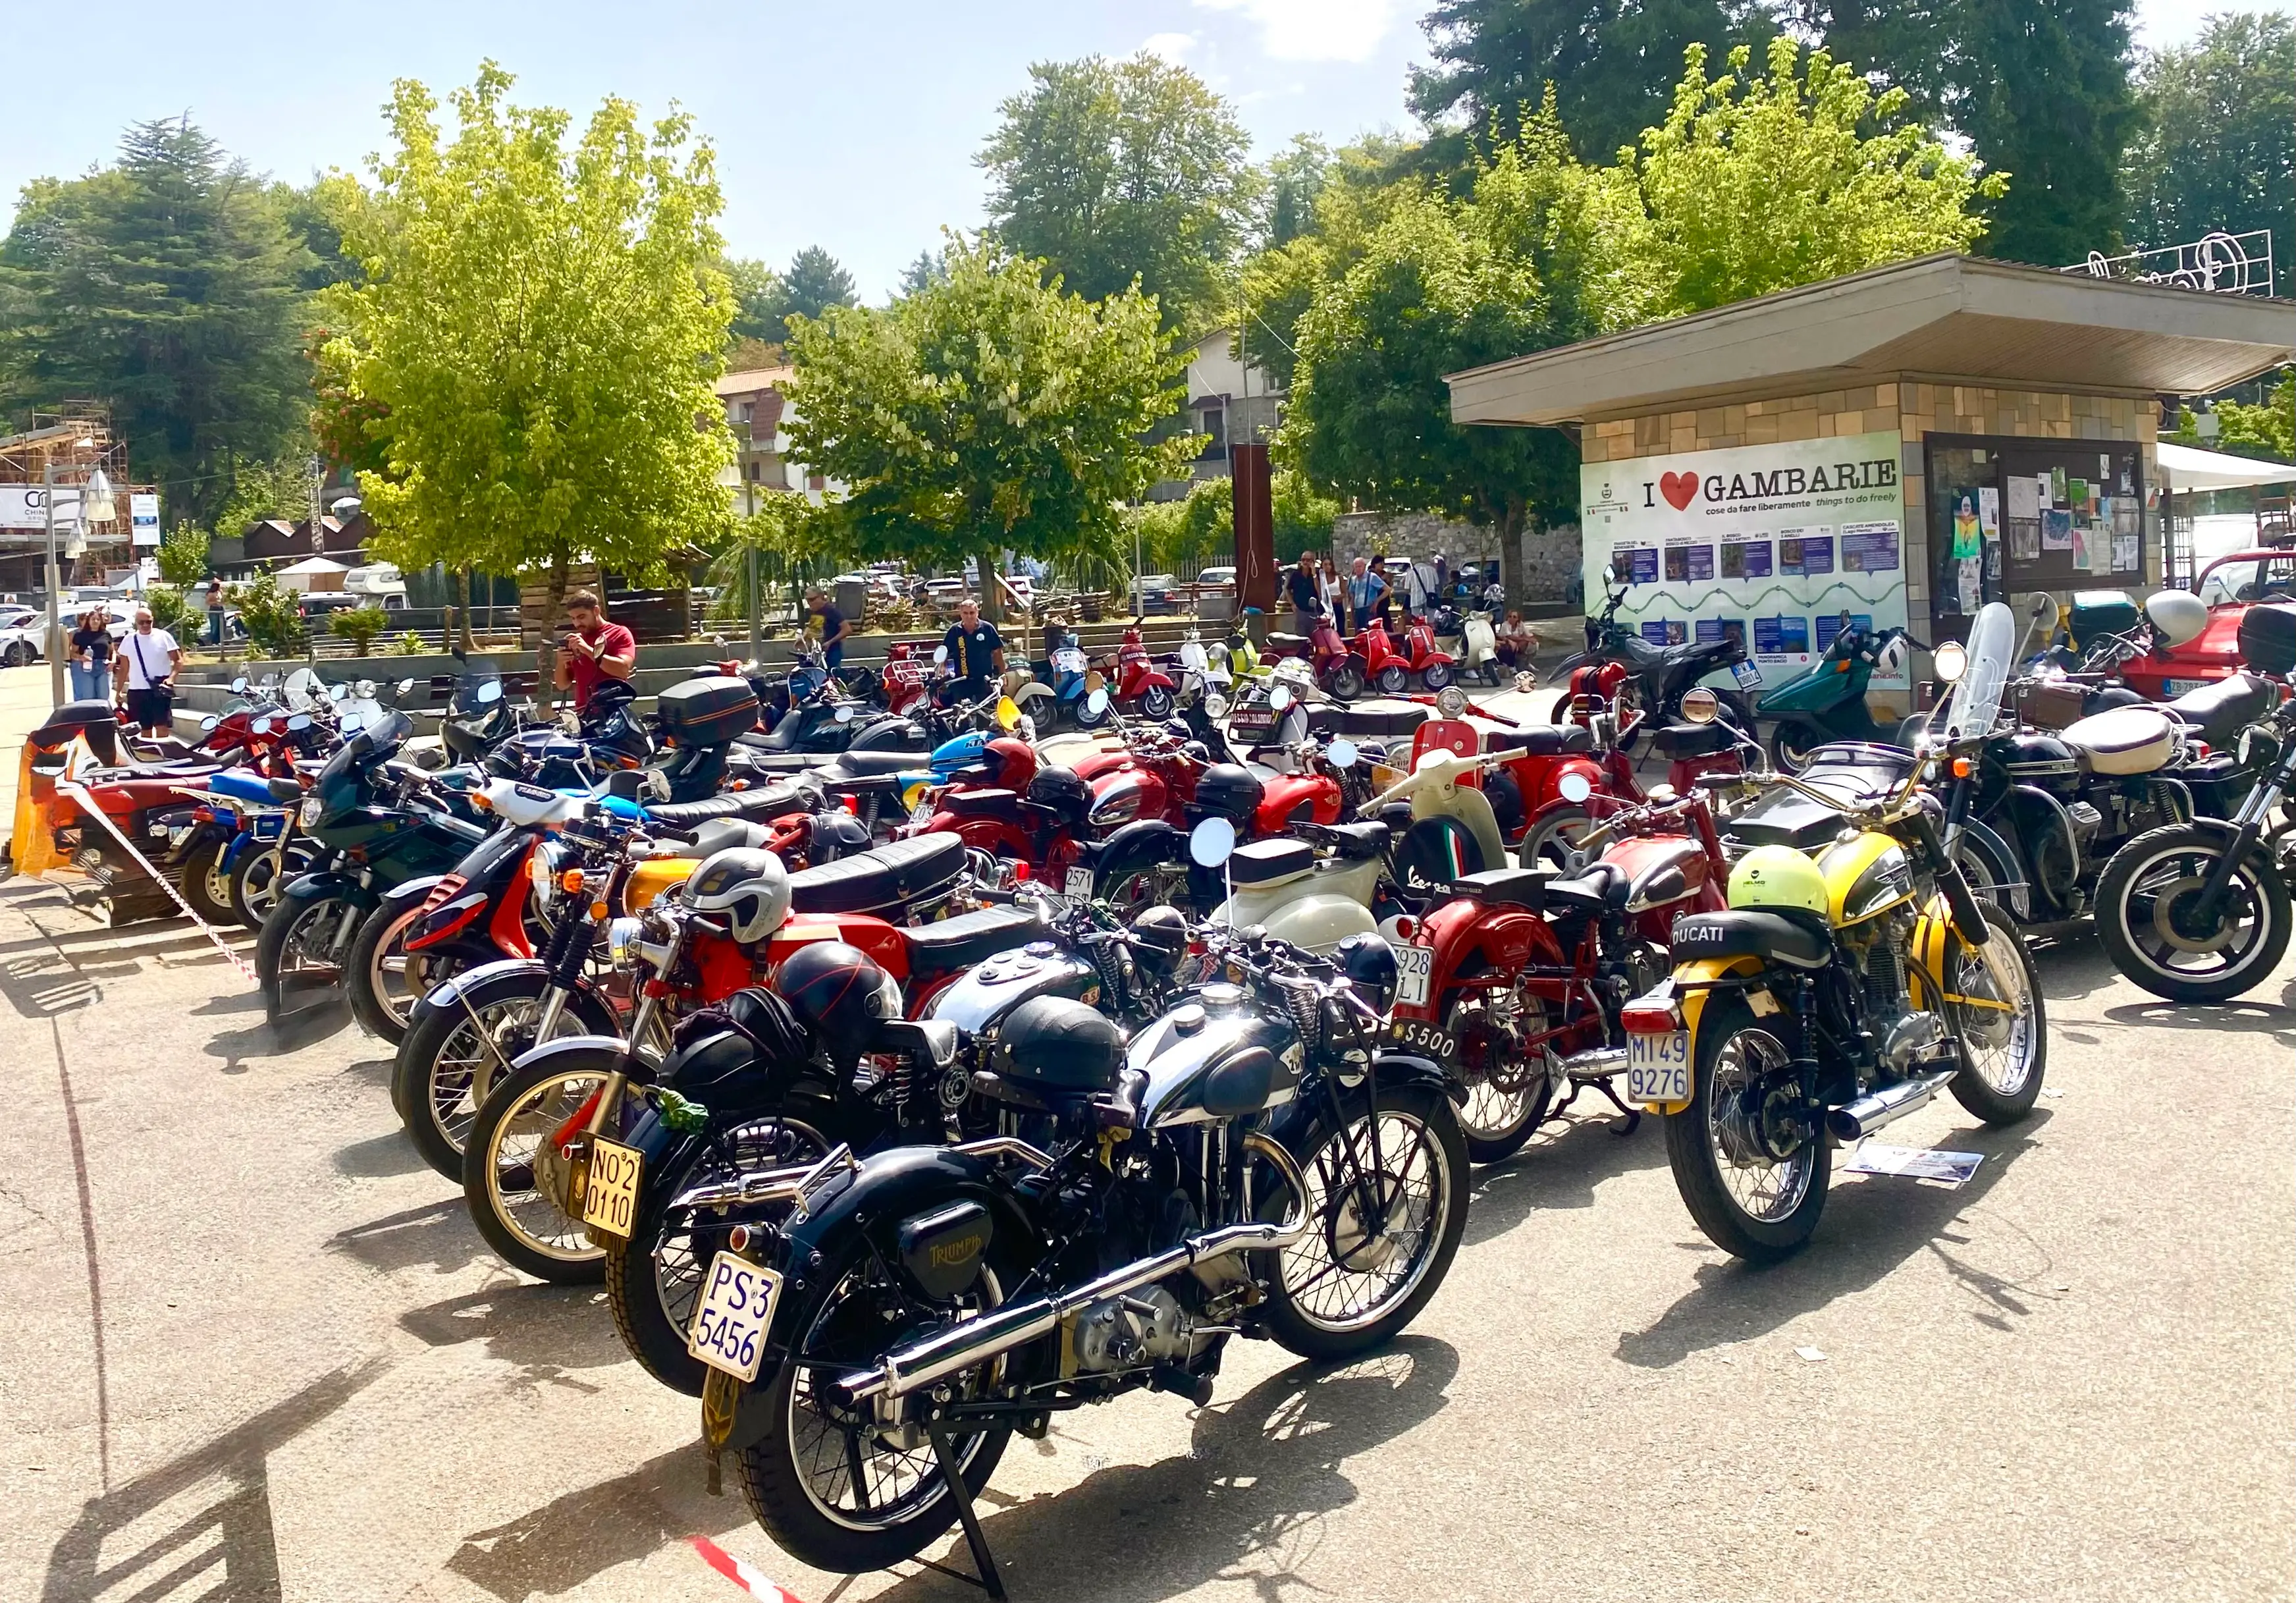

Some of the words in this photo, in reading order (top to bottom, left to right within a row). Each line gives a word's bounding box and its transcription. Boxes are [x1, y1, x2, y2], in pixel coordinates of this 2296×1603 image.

[1643, 483, 1655, 507] I
[1704, 459, 1896, 502] GAMBARIE
[1758, 500, 1811, 511] liberamente
[1816, 497, 1842, 507] things
[1856, 495, 1868, 503] do
[1869, 493, 1896, 503] freely
[1067, 869, 1090, 888] 2571
[1407, 865, 1451, 894] Vespa
[1672, 927, 1724, 945] DUCATI
[1395, 949, 1429, 975] 928
[1632, 1068, 1686, 1095] 9276
[588, 1185, 629, 1228] 0110
[929, 1234, 982, 1267] TRIUMPH
[697, 1308, 759, 1367] 5456
